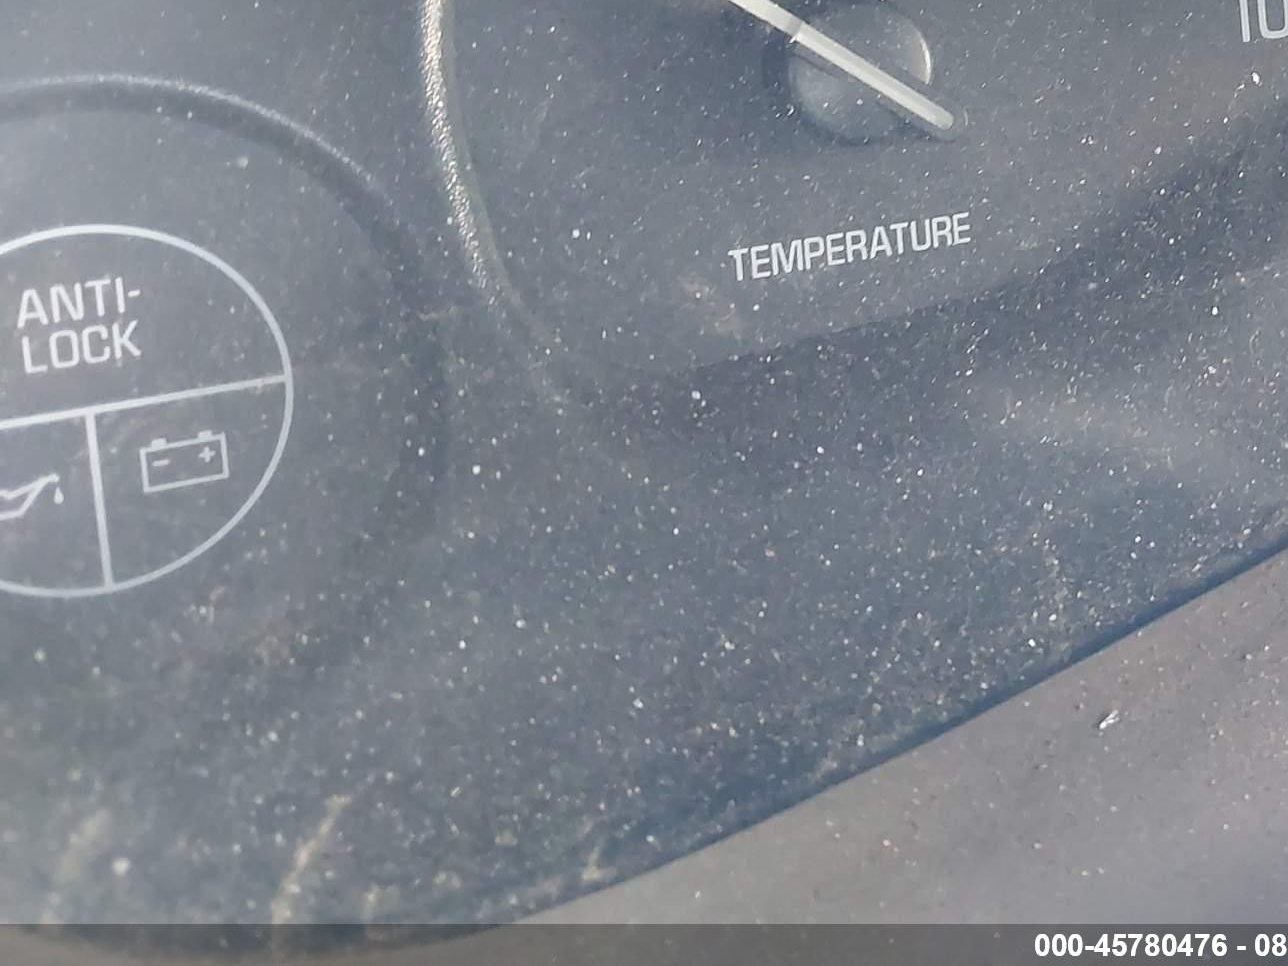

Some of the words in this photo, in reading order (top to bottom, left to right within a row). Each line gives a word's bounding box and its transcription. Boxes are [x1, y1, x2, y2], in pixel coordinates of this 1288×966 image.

[727, 211, 972, 281] TEMPERATURE
[16, 276, 141, 329] ANTI-
[21, 320, 142, 374] LOCK
